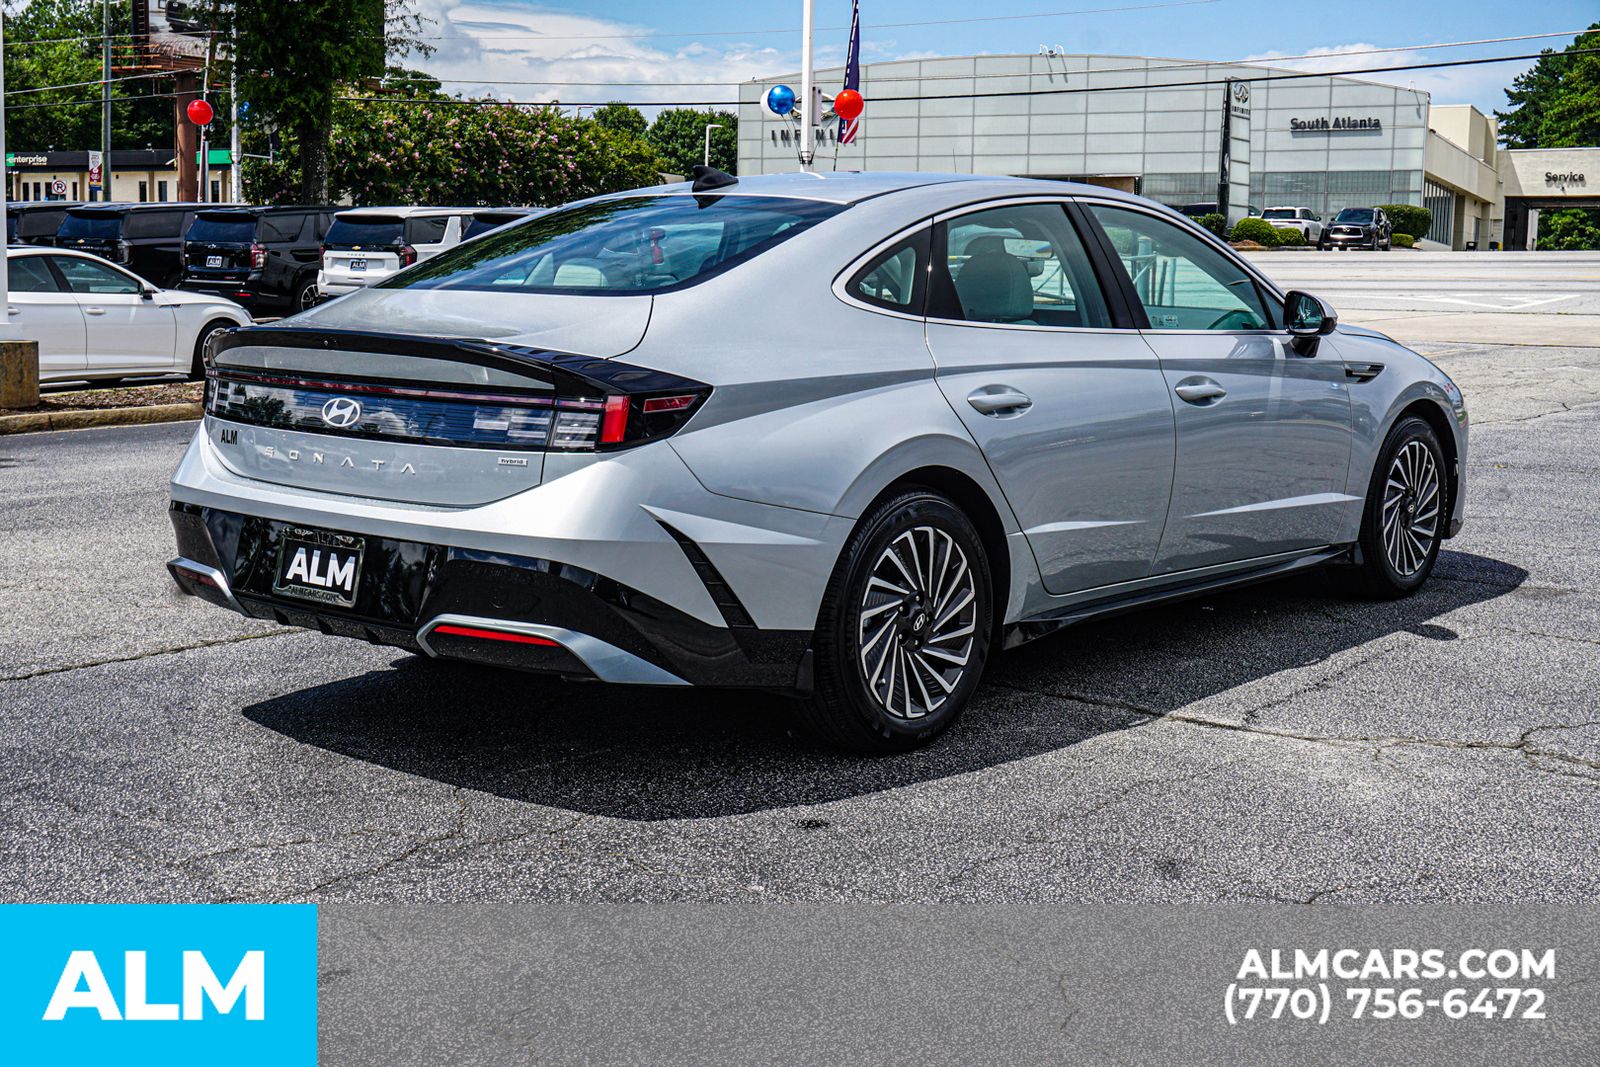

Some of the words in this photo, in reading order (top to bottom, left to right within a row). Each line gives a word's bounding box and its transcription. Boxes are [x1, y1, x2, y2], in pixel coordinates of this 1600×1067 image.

[1290, 117, 1329, 130] South
[1332, 116, 1381, 129] Atlanta
[7, 155, 48, 164] enterprise
[1545, 171, 1585, 182] Service
[209, 258, 221, 266] ALM
[220, 429, 238, 445] ALM
[264, 446, 416, 475] SONATA
[286, 547, 356, 591] ALM
